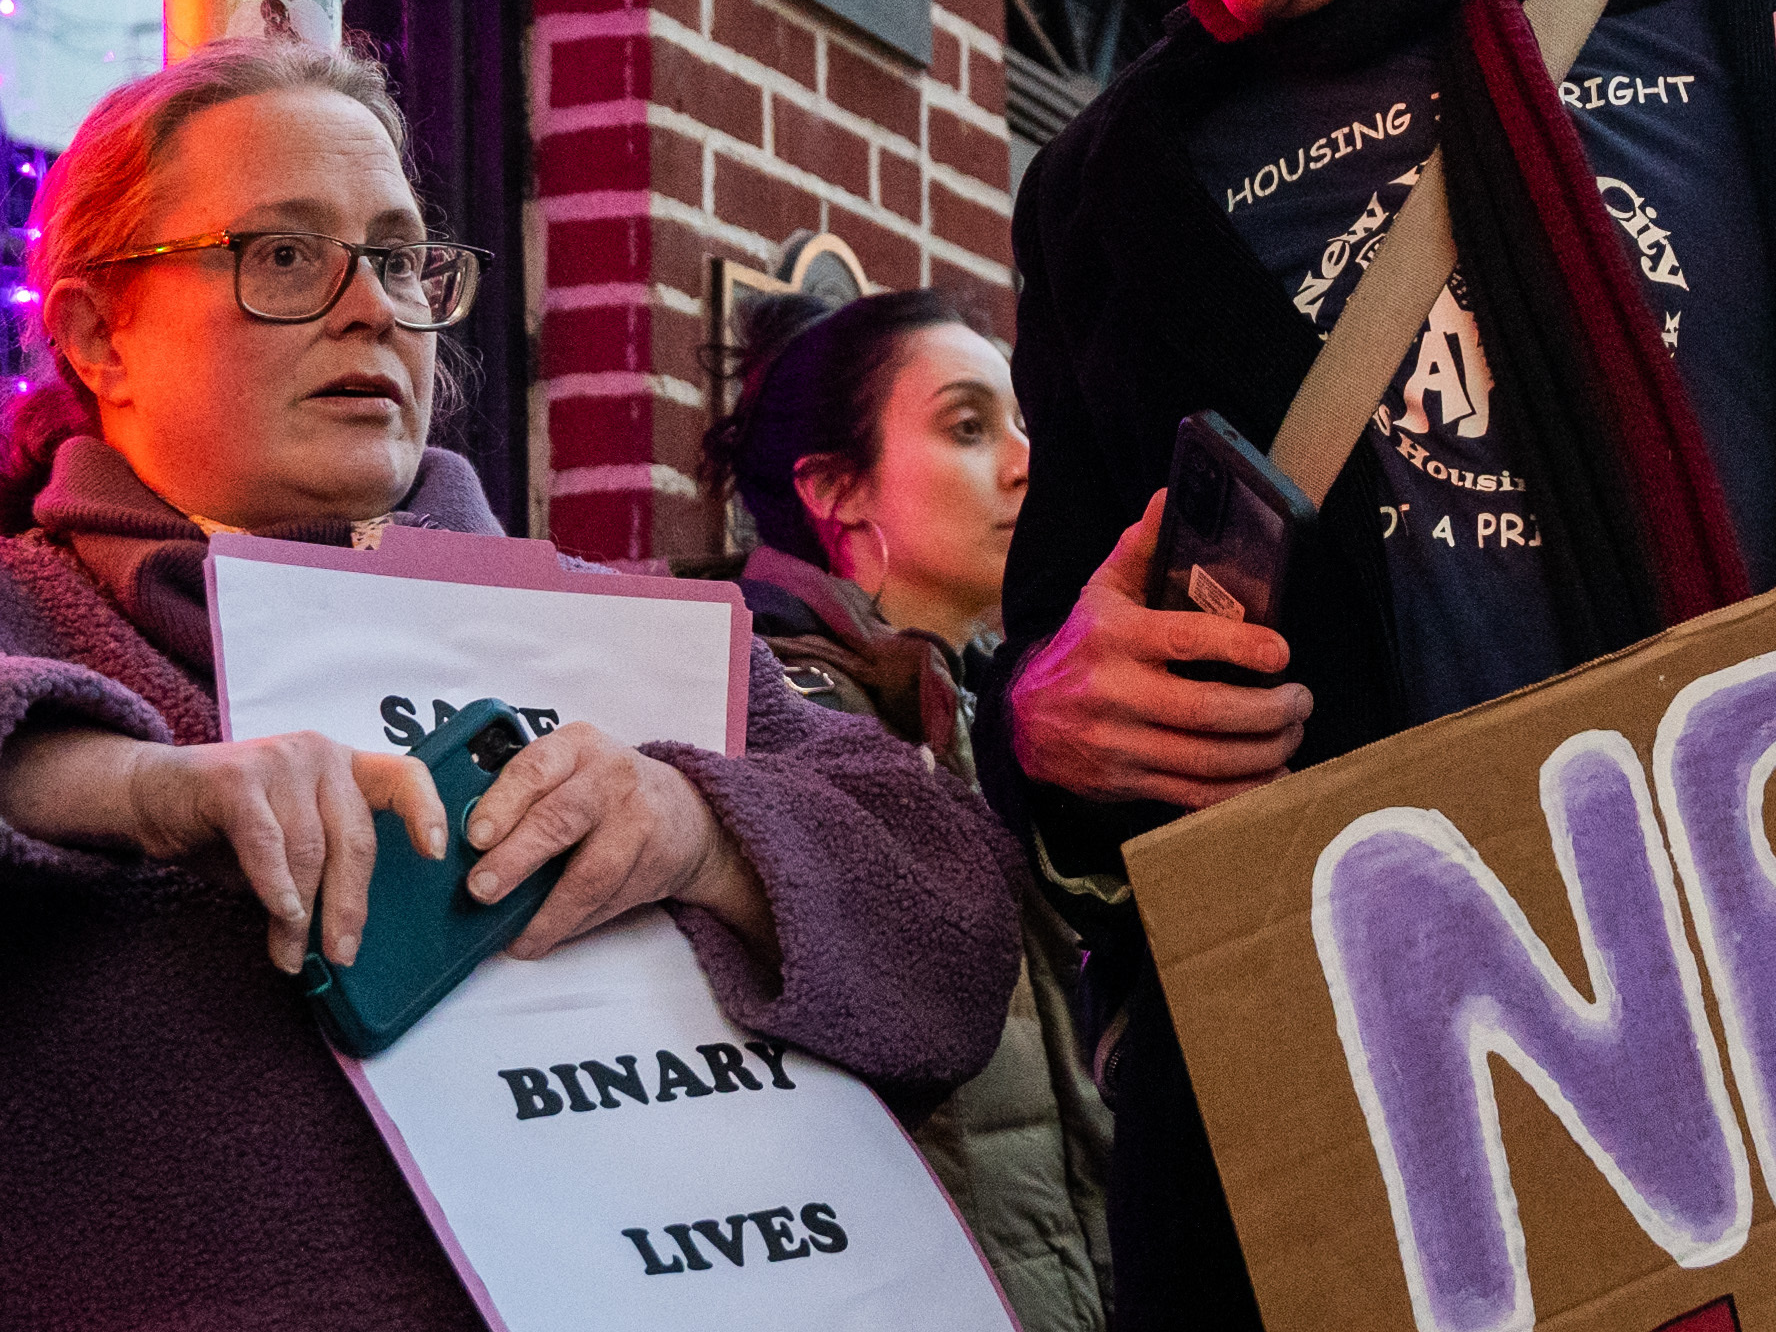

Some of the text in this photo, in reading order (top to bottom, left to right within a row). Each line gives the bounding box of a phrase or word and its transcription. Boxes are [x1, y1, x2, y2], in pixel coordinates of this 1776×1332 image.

[1227, 102, 1411, 212] HOUSING
[1558, 74, 1695, 110] RIGHT
[1292, 176, 1690, 324] New City
[1431, 515, 1455, 548] A
[497, 1041, 797, 1121] BINARY
[621, 1202, 849, 1276] LIVES
